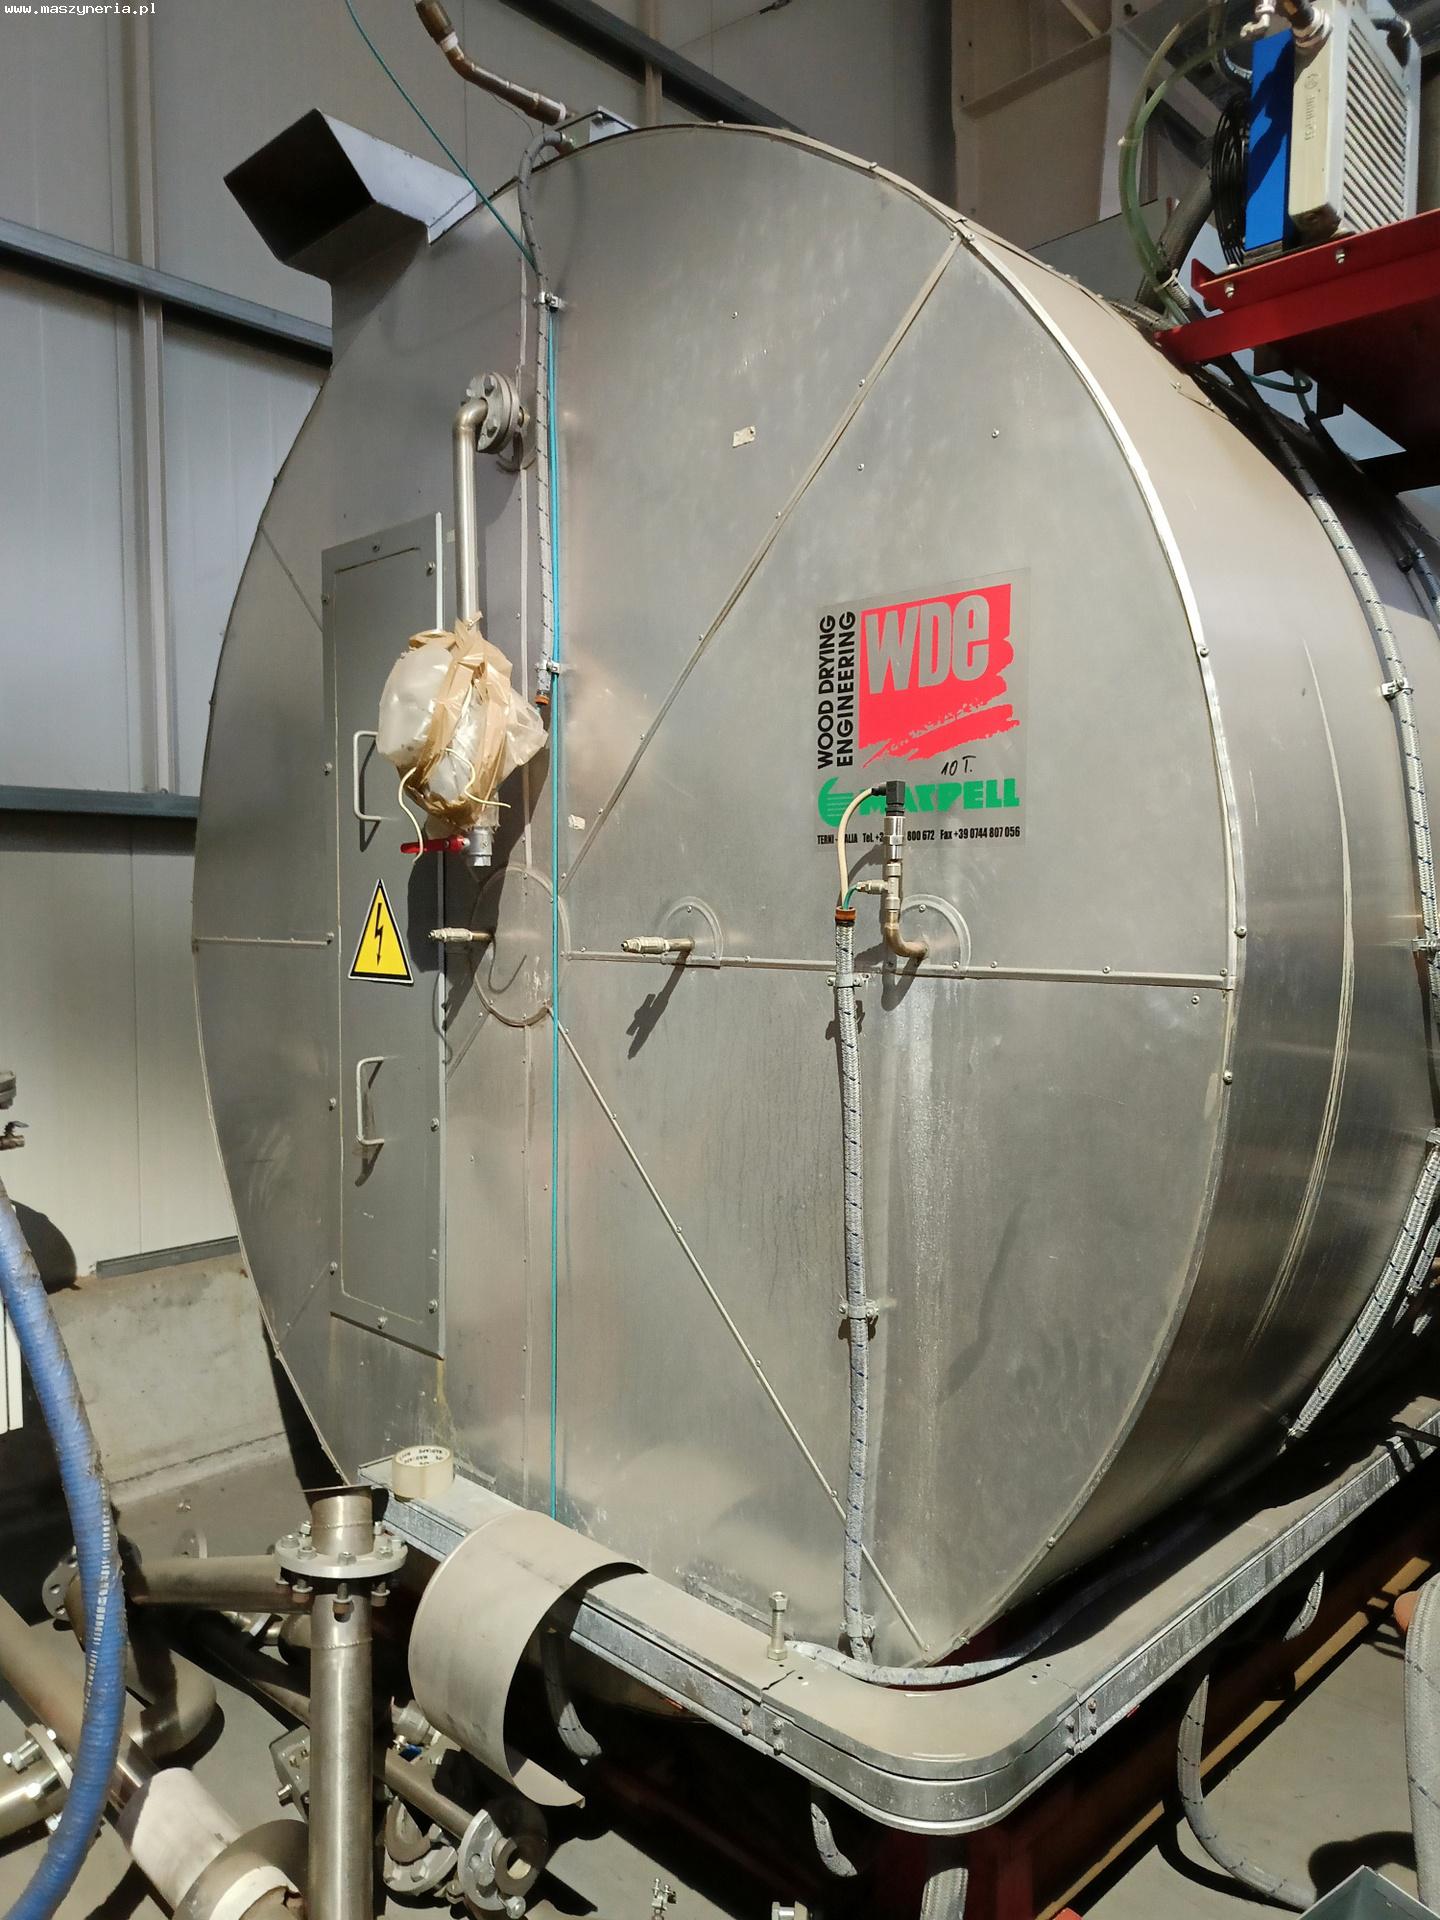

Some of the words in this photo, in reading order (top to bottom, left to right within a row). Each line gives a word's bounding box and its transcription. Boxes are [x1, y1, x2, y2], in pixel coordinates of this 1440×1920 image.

[818, 614, 836, 694] DRYING
[836, 611, 856, 767] ENGINEERING
[817, 699, 834, 769] WOOD
[941, 759, 958, 777] 10
[922, 830, 935, 841] 672
[940, 829, 953, 840] Fax
[954, 828, 968, 839] +39
[969, 827, 988, 839] 0744
[989, 826, 1003, 838] 807
[1004, 825, 1020, 837] 056
